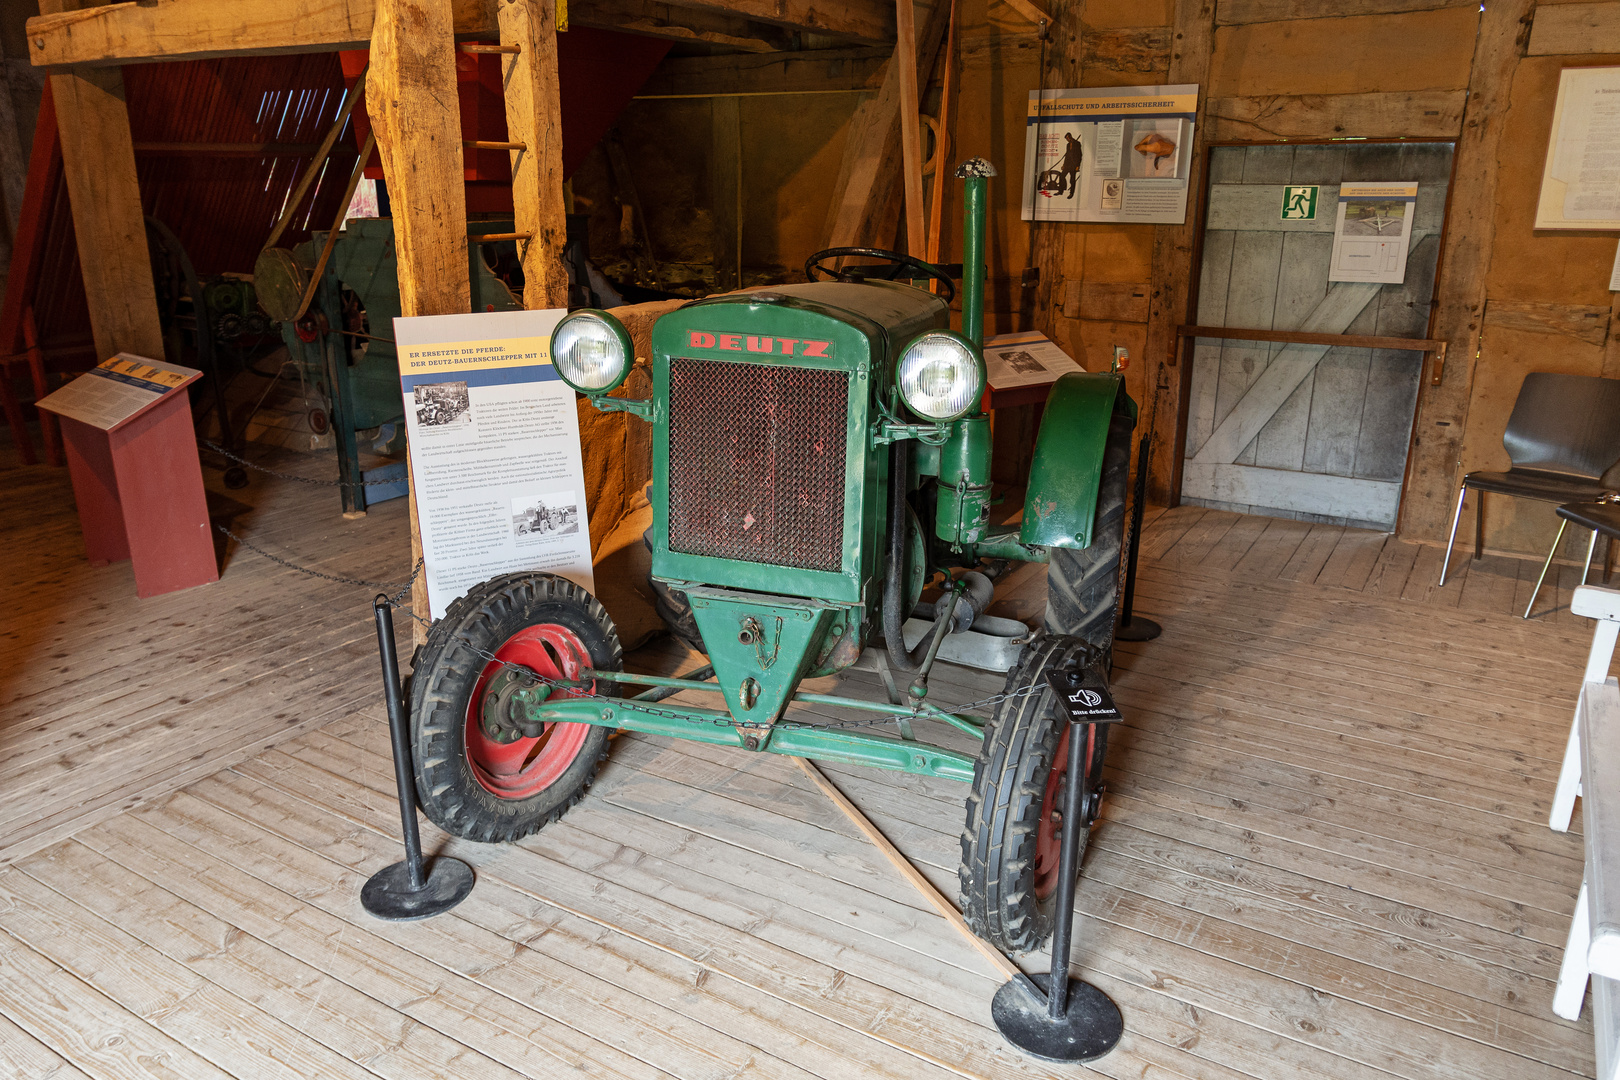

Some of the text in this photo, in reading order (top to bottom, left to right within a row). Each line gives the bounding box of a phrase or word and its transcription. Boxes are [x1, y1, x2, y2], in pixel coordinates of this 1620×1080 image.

[1101, 100, 1176, 109] ARBEITSSICHERHEIT
[690, 331, 830, 358] DEUTZ
[422, 349, 460, 358] ERSETZTE
[428, 354, 523, 366] DEUTZ-BAUERNSCHLEPPER
